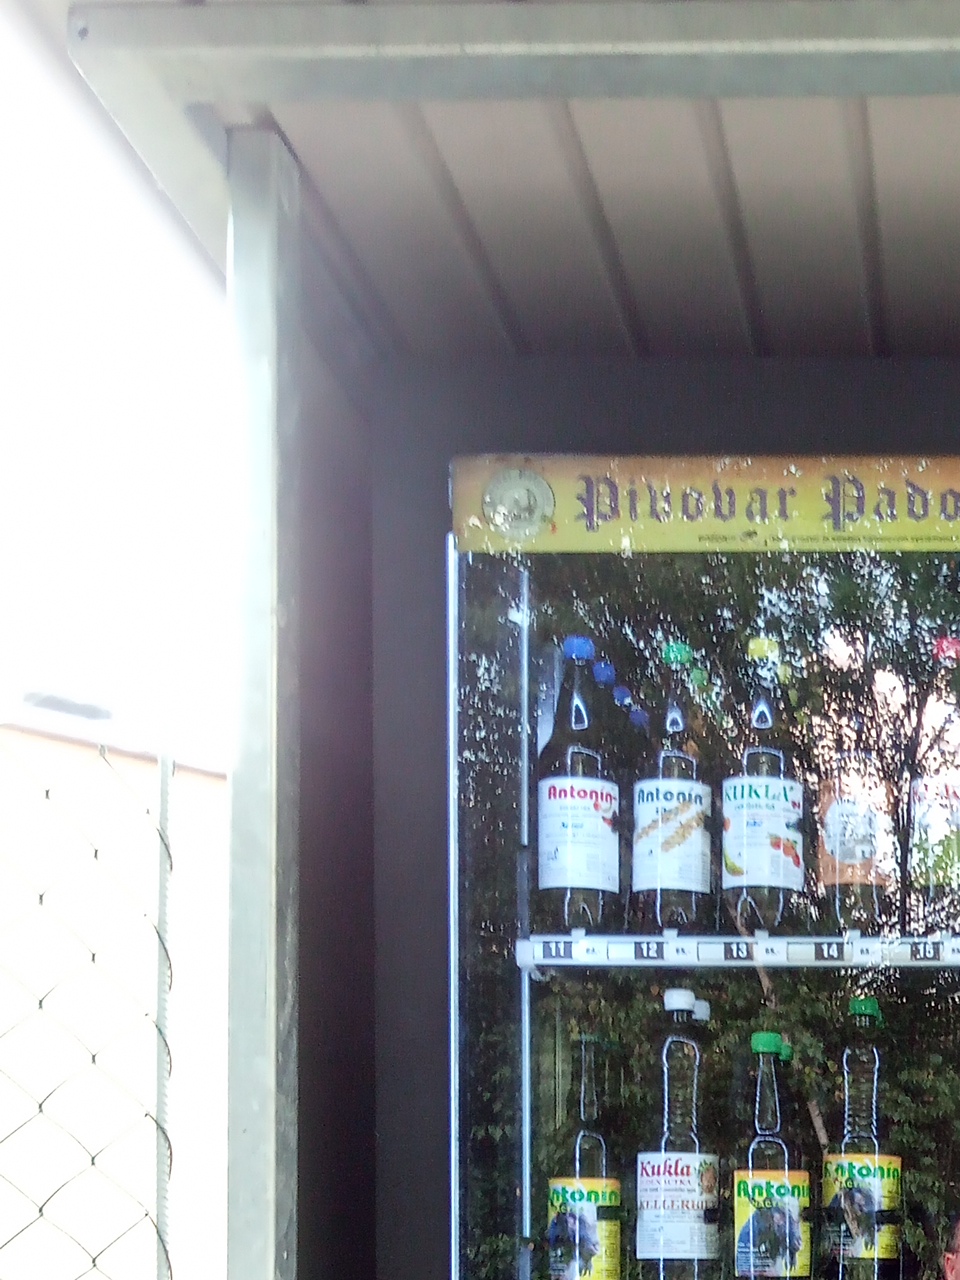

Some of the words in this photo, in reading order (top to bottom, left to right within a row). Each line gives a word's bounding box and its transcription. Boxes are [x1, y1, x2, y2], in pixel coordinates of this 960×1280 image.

[575, 474, 797, 532] Pivovar
[821, 942, 839, 958] 14
[641, 1157, 692, 1178] Kukla
[549, 1185, 620, 1205] ntonín
